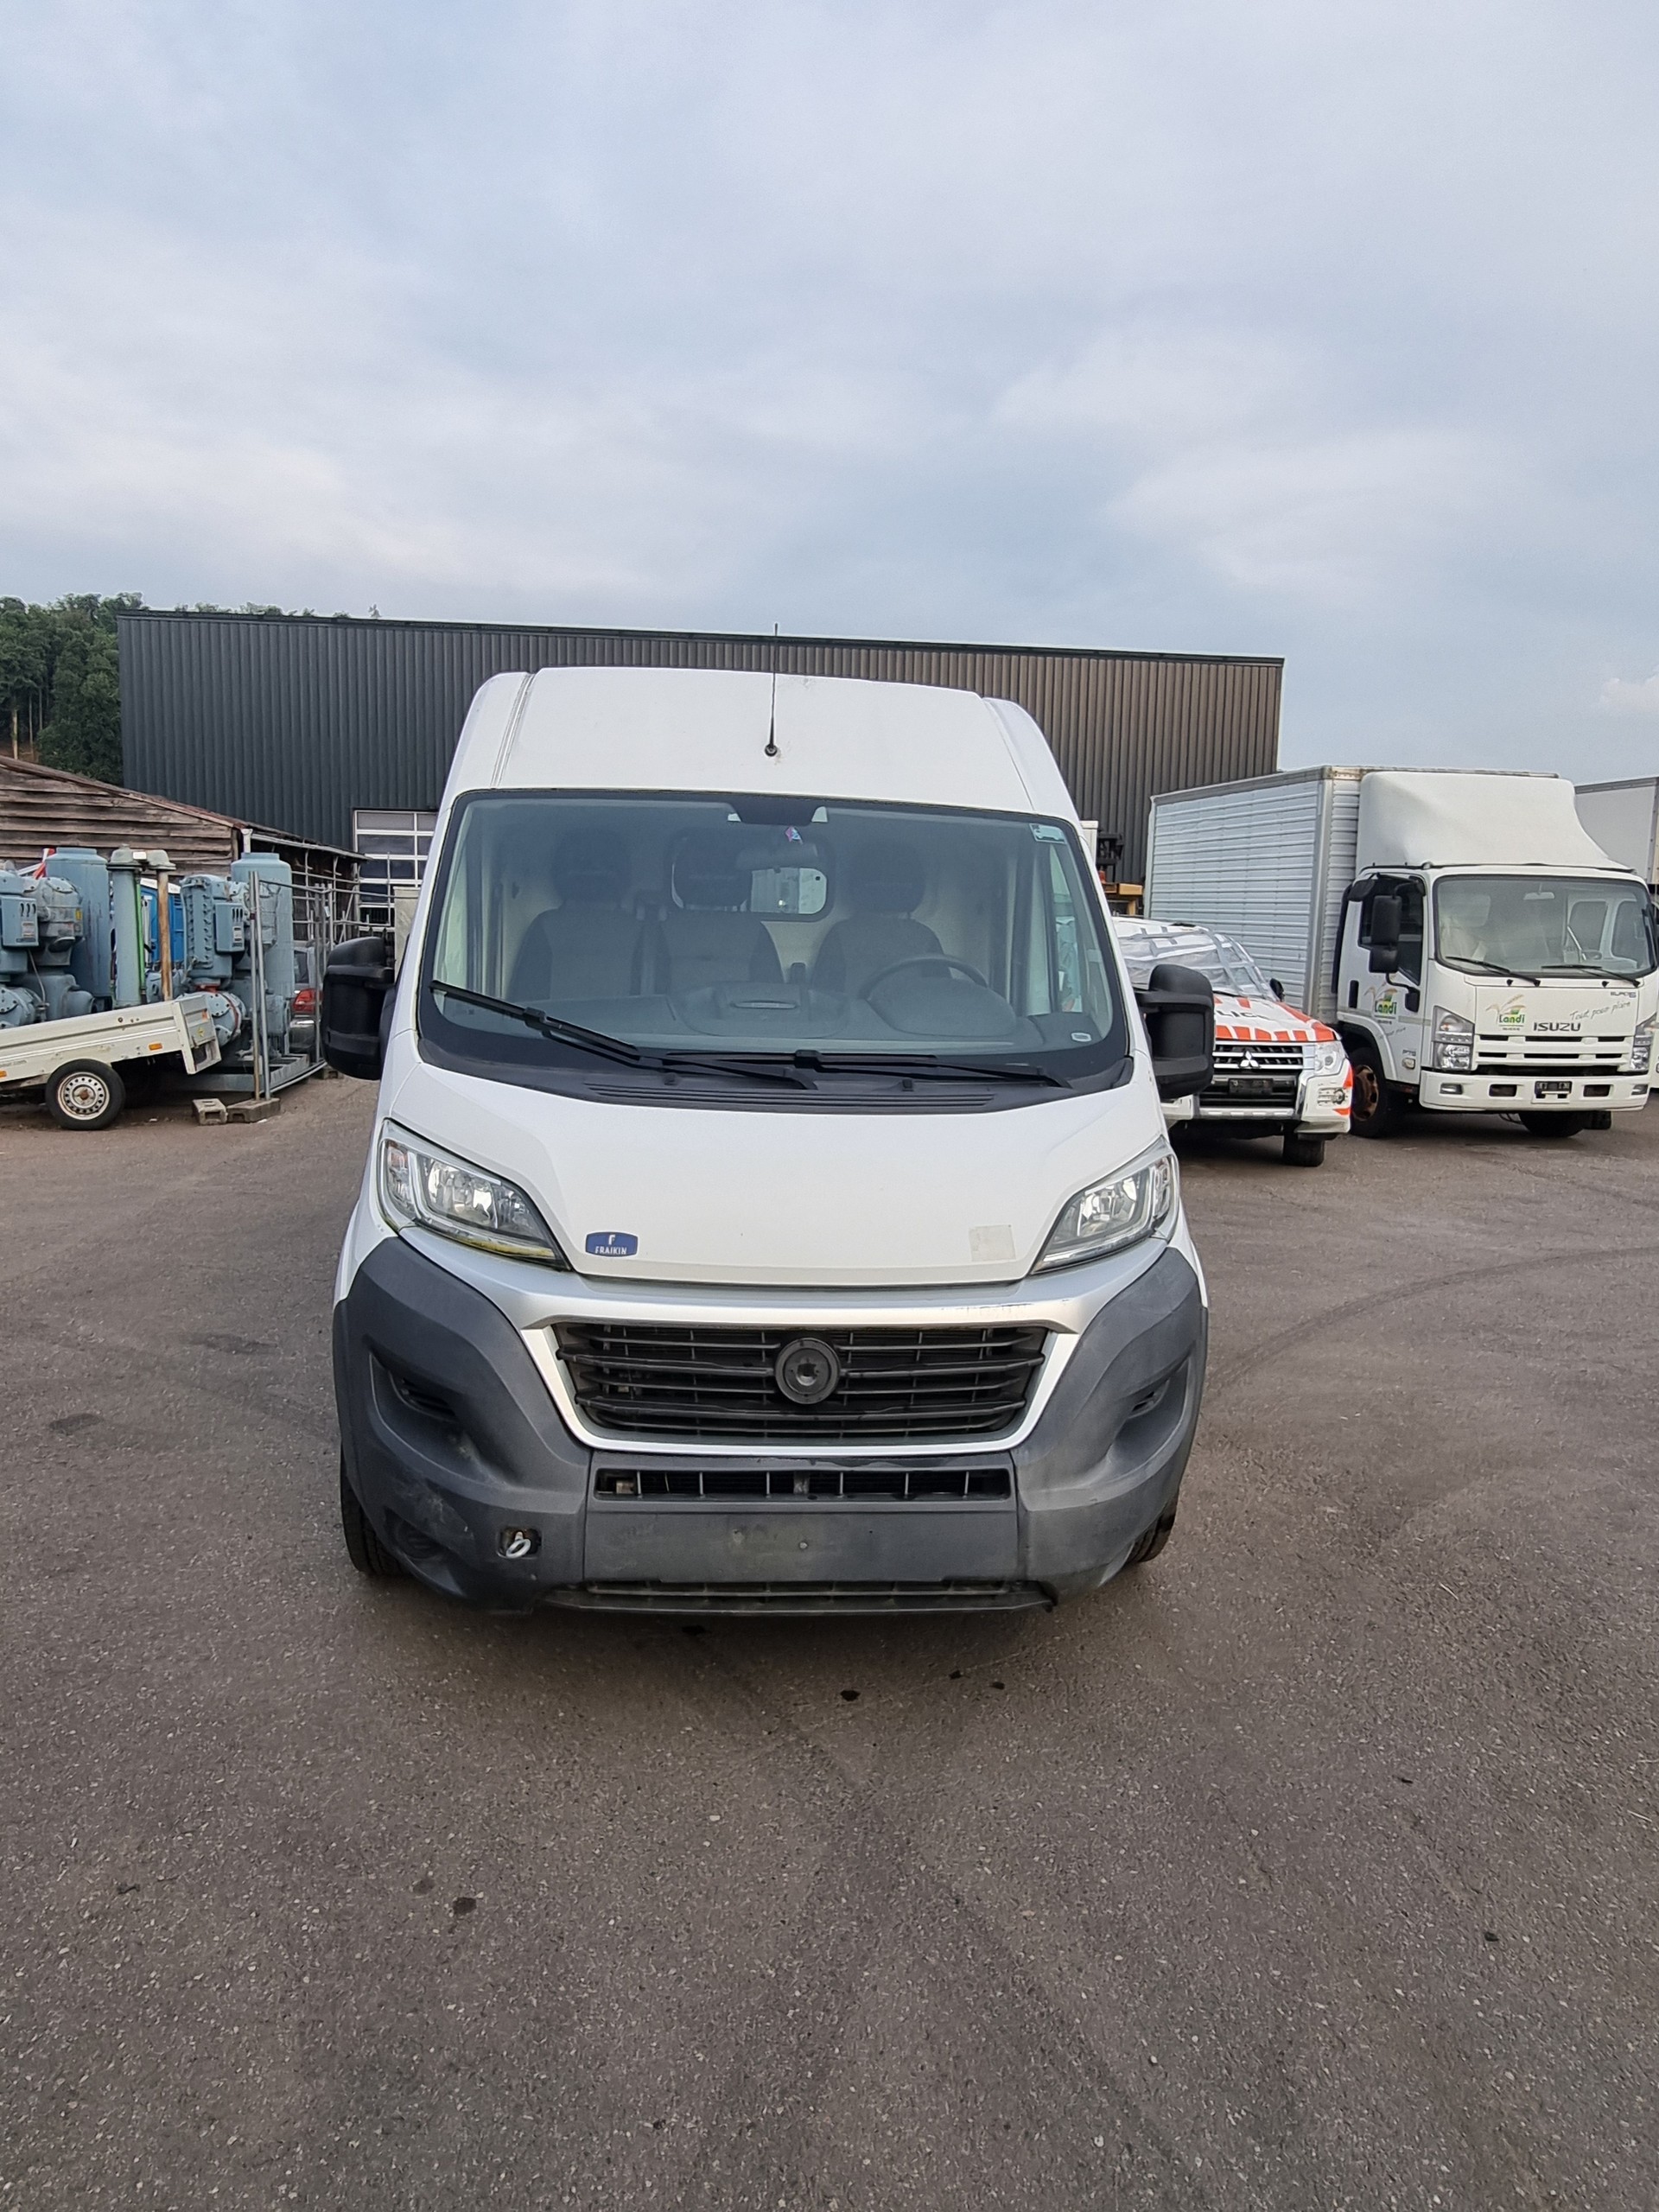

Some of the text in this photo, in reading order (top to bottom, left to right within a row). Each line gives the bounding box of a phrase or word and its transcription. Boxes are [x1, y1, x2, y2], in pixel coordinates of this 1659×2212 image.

[1374, 1000, 1397, 1014] Landi
[1498, 1014, 1525, 1024] Landi
[1533, 1022, 1581, 1032] ISUZU
[594, 1246, 627, 1255] FRAIKIN
